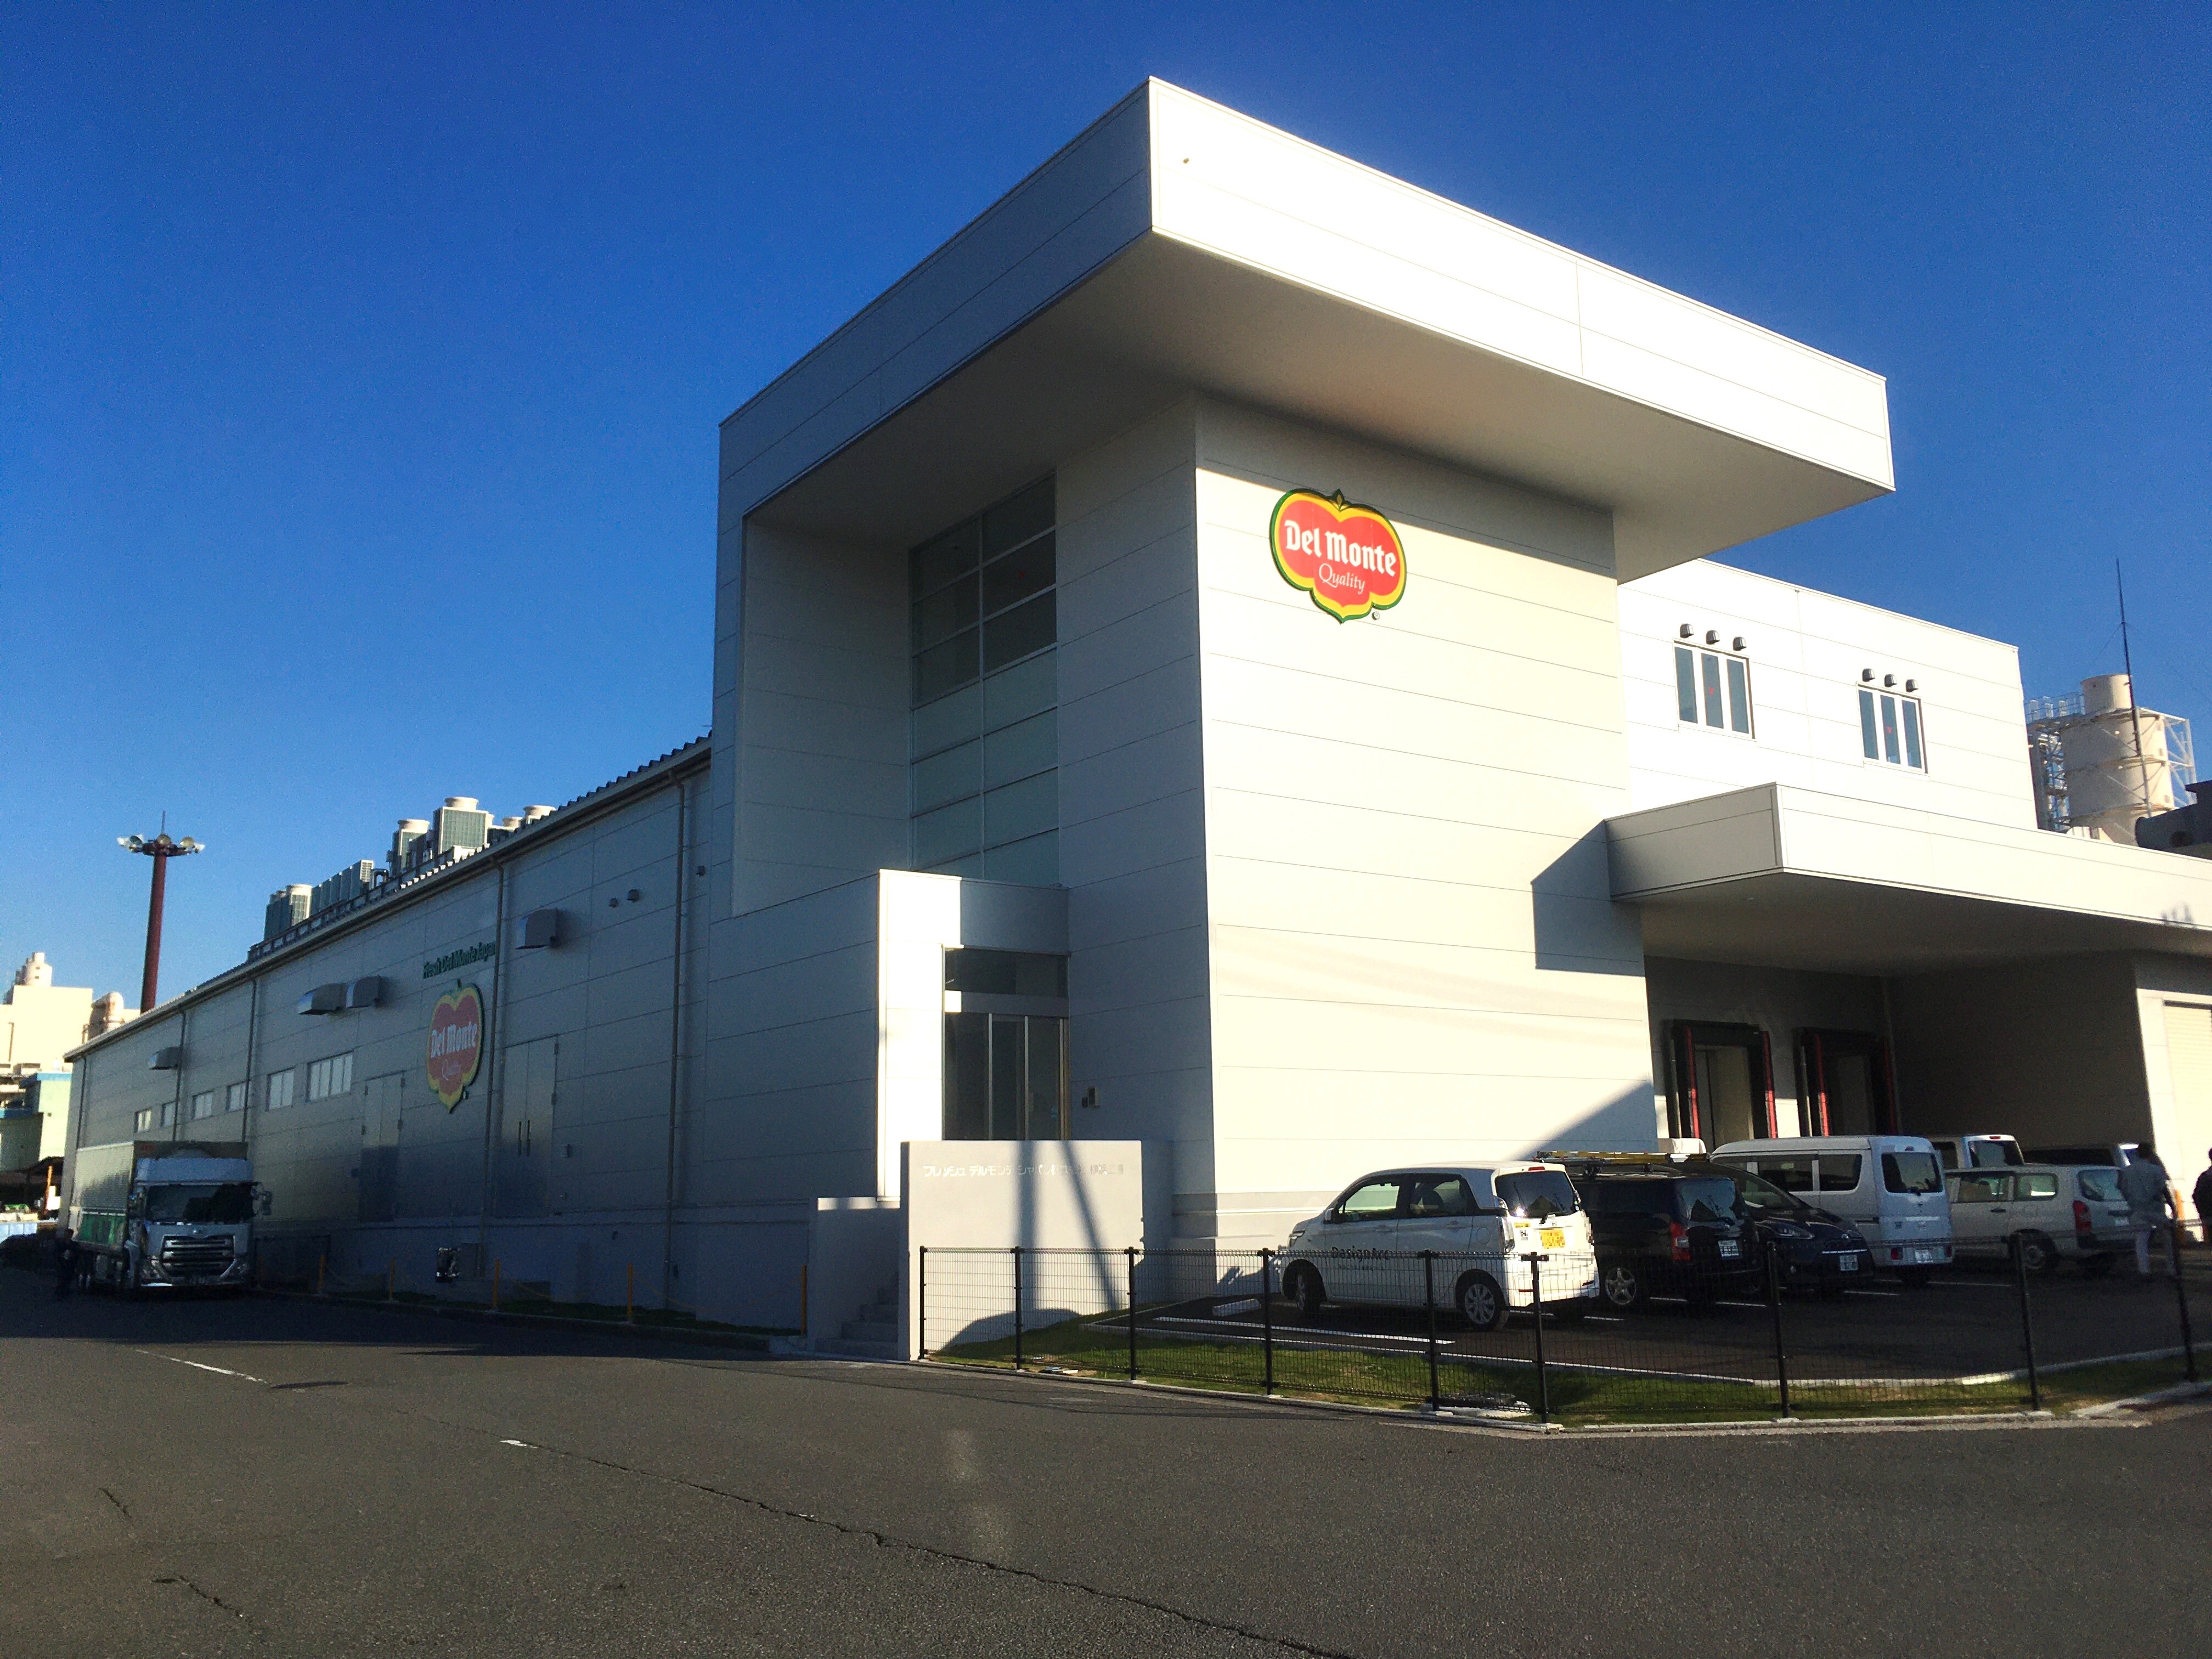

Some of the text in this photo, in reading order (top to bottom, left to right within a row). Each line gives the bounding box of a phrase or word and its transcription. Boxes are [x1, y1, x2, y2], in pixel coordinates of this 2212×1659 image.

[1284, 519, 1396, 577] Del Monte
[1318, 563, 1365, 595] Quality
[454, 946, 477, 967] Monte
[477, 940, 495, 962] Japan
[431, 1020, 477, 1058] Del Monte
[969, 1164, 1012, 1176] デルモンテ
